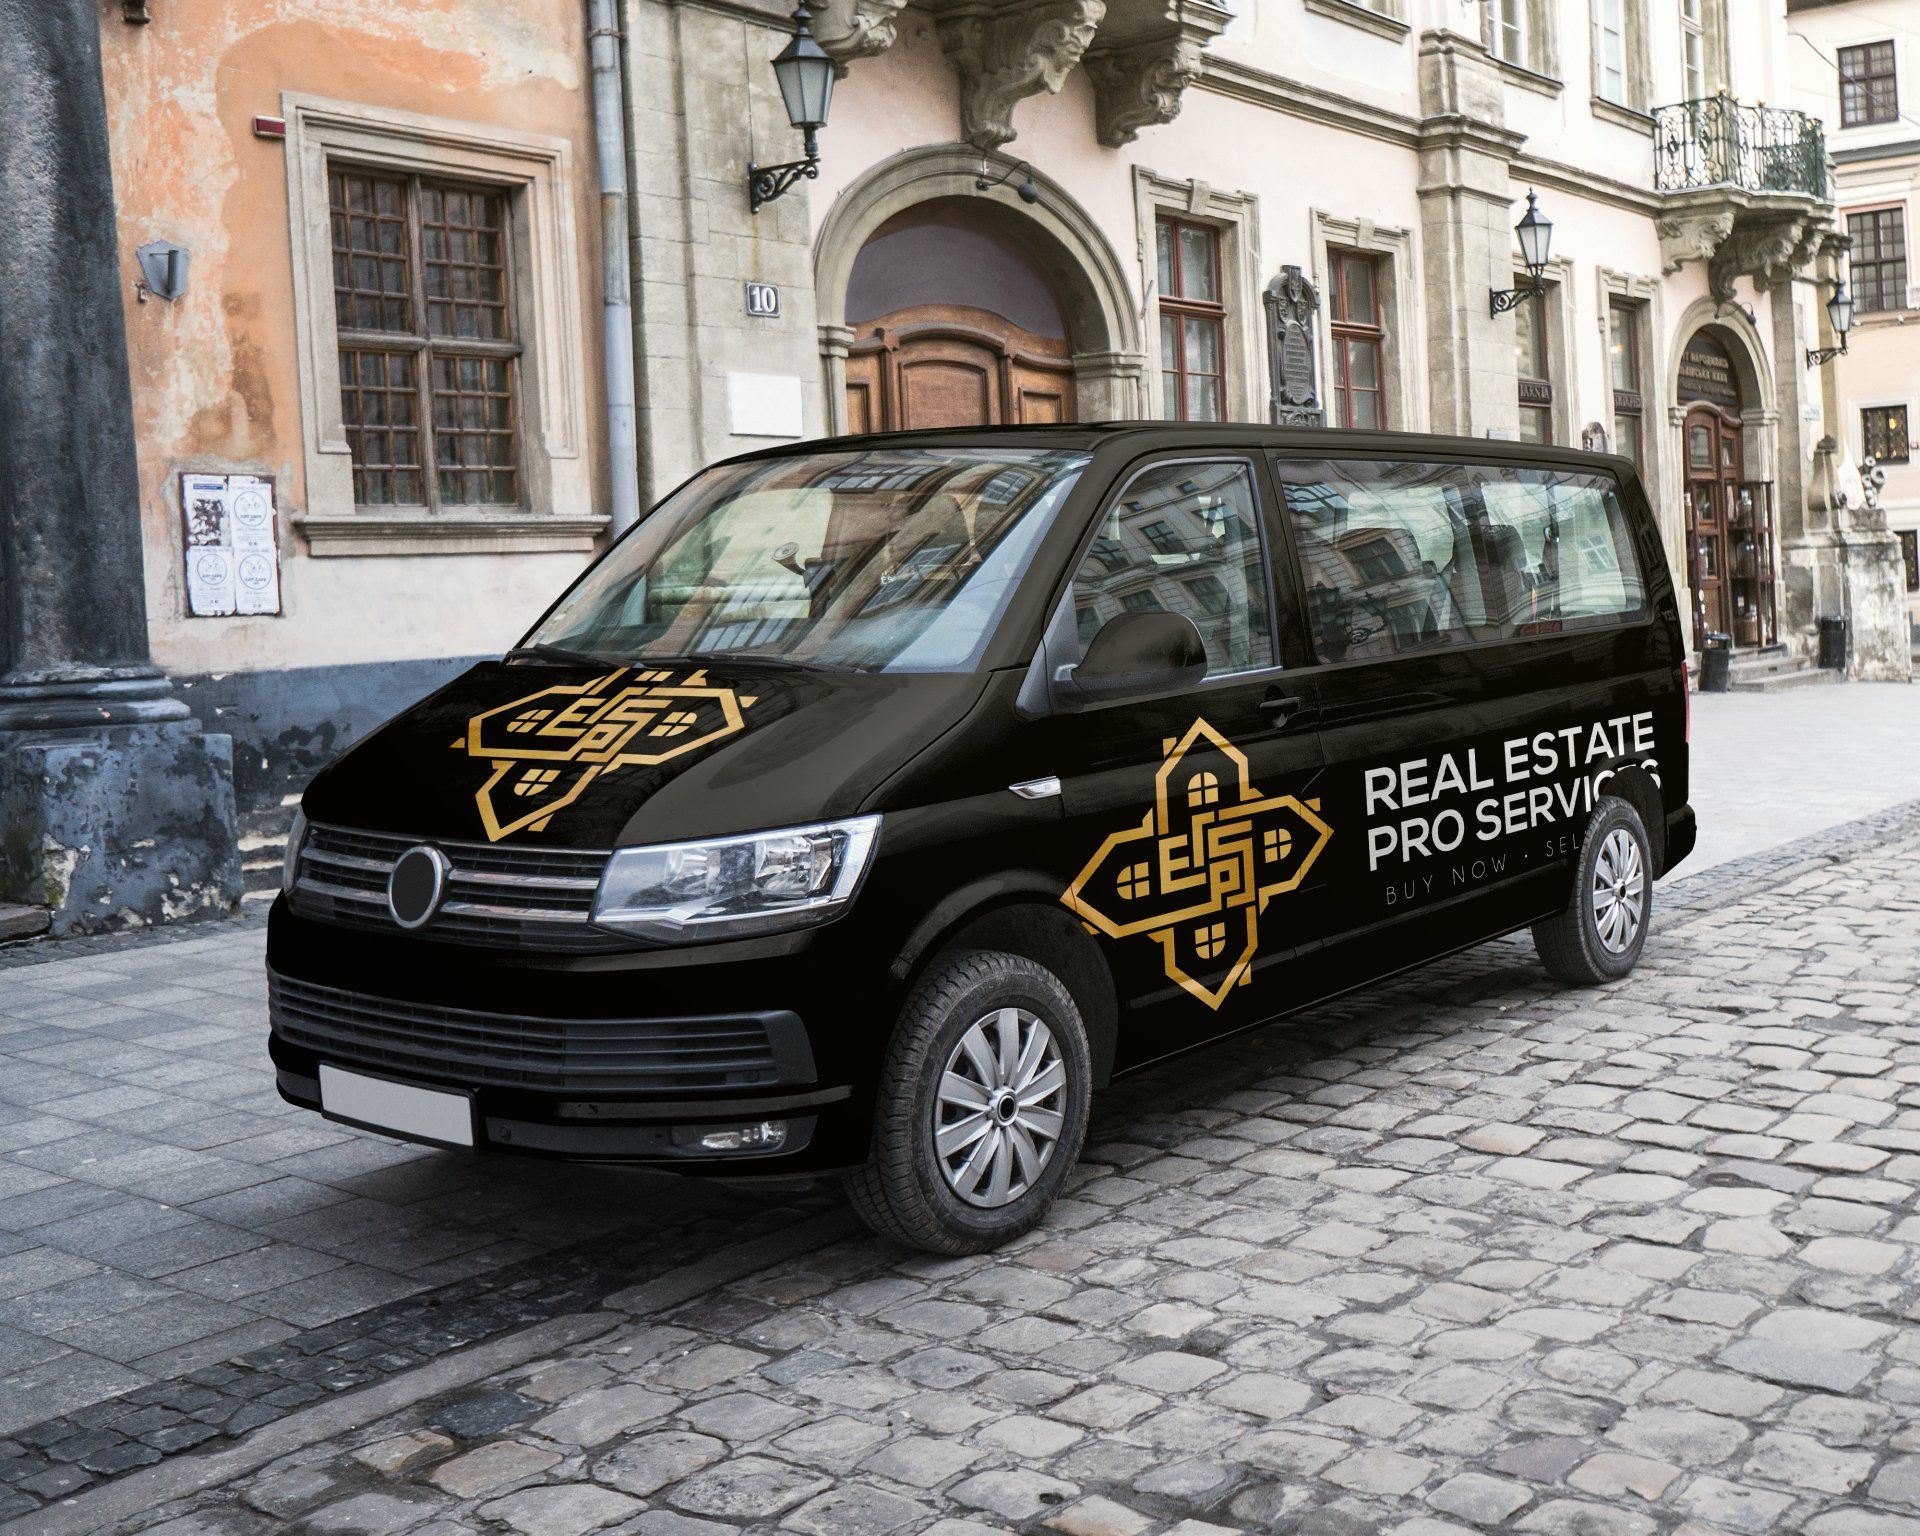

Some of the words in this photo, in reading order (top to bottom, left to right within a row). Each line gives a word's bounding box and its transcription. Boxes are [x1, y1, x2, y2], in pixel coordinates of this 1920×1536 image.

[750, 286, 776, 313] 10
[1364, 748, 1494, 815] REAL
[1504, 711, 1655, 783] ESTATE
[1367, 808, 1465, 872] PRO
[1475, 758, 1661, 841] SERVICS
[1386, 876, 1433, 905] BUY
[1452, 853, 1507, 885] NOW
[1546, 830, 1587, 857] SEL
